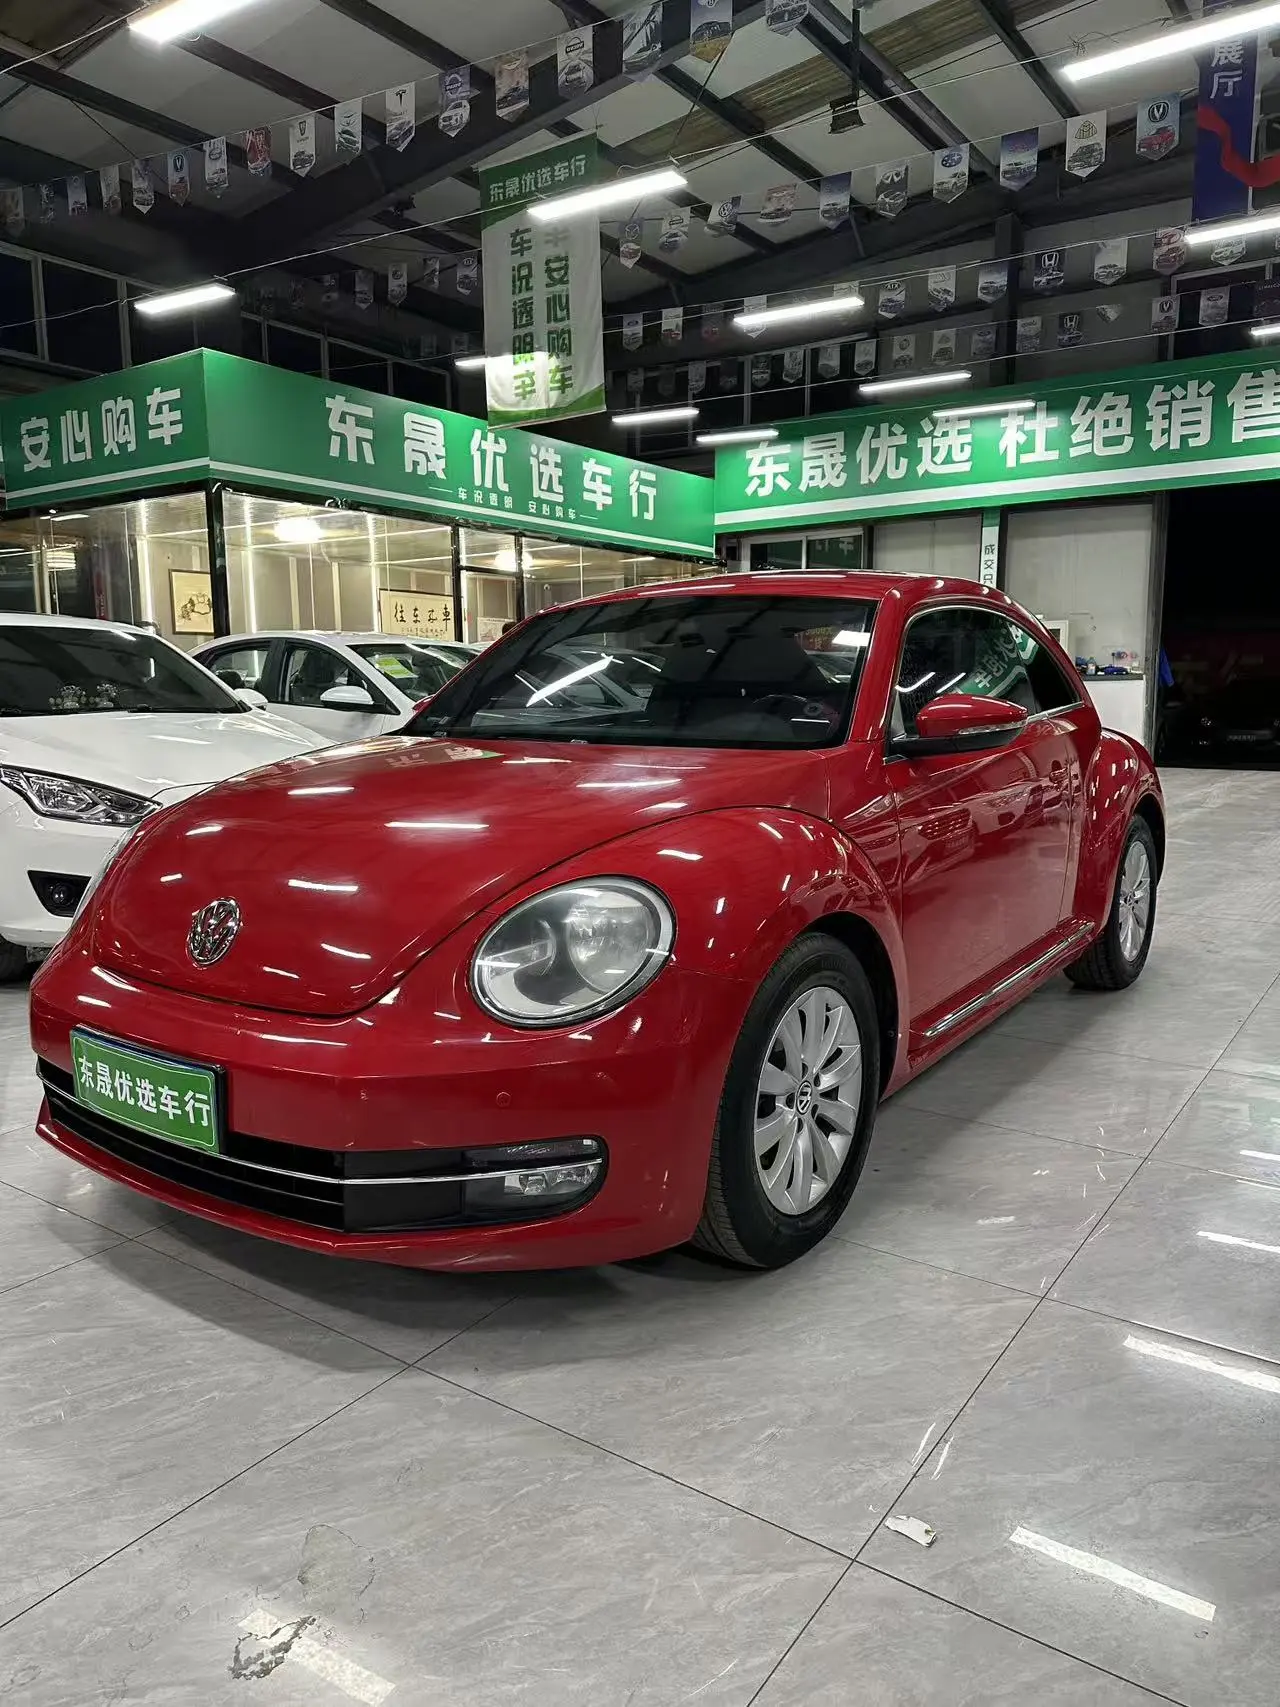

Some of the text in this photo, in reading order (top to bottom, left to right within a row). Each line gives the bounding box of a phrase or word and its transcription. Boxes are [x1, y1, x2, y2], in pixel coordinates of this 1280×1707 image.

[489, 154, 586, 203] 东晟优选车行
[20, 386, 183, 473] 安心购车
[325, 394, 658, 521] 东晟优选车行
[744, 370, 1280, 497] 东晟优选 杜绝销售
[457, 487, 577, 520] 车况透明 安心购车
[78, 1055, 211, 1127] 东晟优选车行
